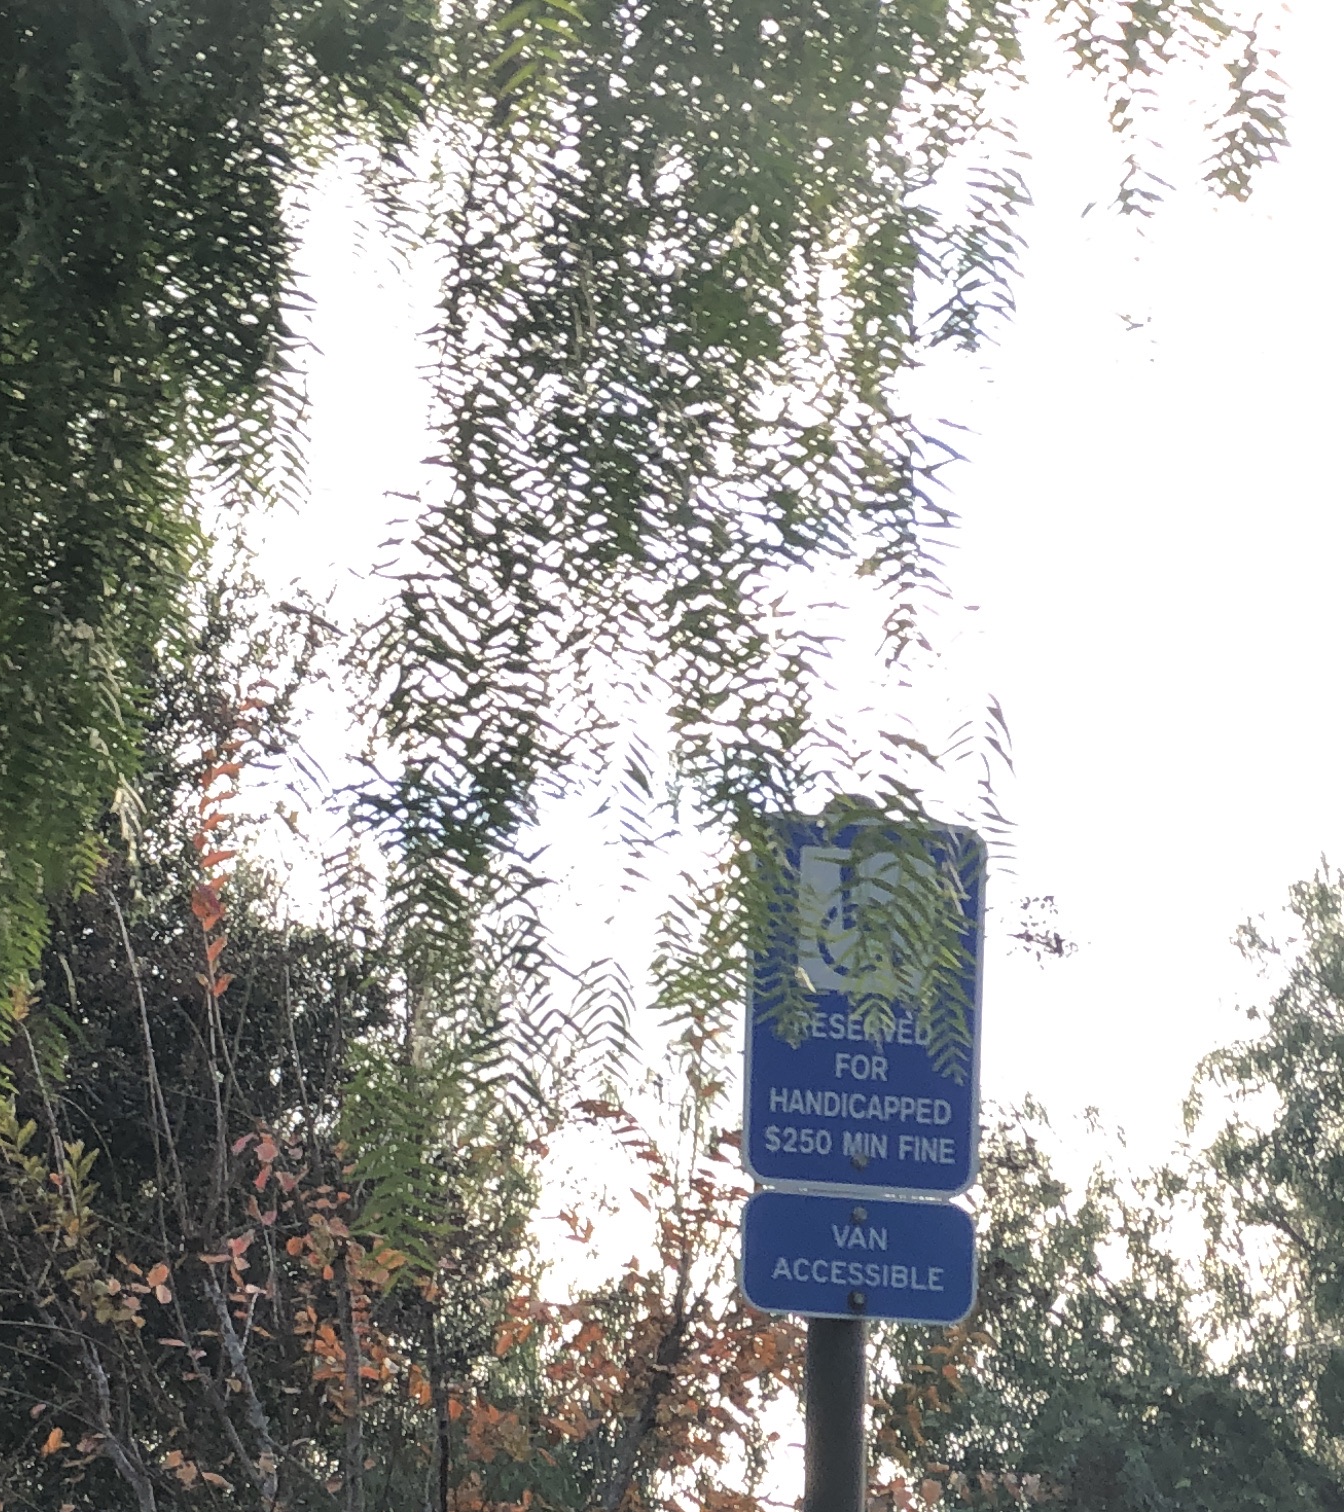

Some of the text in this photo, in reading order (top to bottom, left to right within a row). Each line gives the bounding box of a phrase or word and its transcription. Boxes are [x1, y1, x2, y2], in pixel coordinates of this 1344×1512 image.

[834, 1052, 888, 1083] FOR
[768, 1086, 952, 1126] HANDICAPPED
[764, 1124, 956, 1165] $250 MIN FINE
[831, 1223, 888, 1252] VAN
[770, 1256, 945, 1293] ACCESSIBLE
